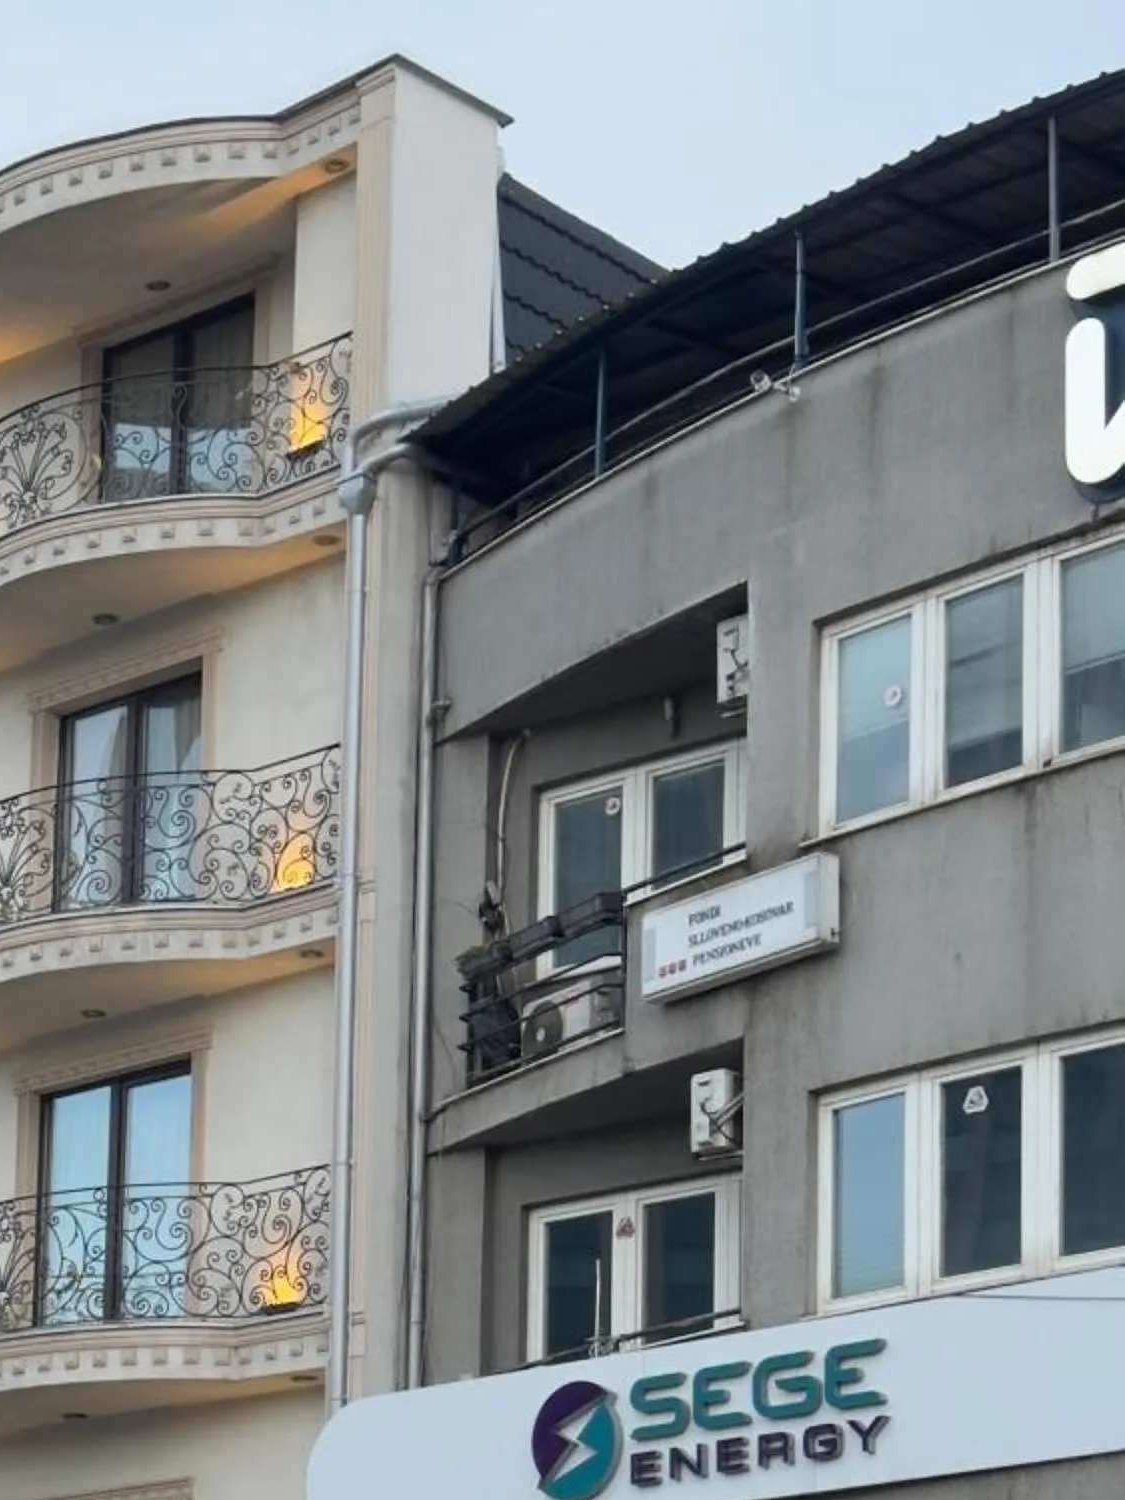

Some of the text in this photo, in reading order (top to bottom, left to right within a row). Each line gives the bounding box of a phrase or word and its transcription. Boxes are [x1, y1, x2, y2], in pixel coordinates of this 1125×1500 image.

[688, 906, 721, 927] FONDI
[693, 934, 762, 966] PENSIONEVE
[630, 1338, 888, 1442] SEGE
[630, 1415, 891, 1488] ENERGY
